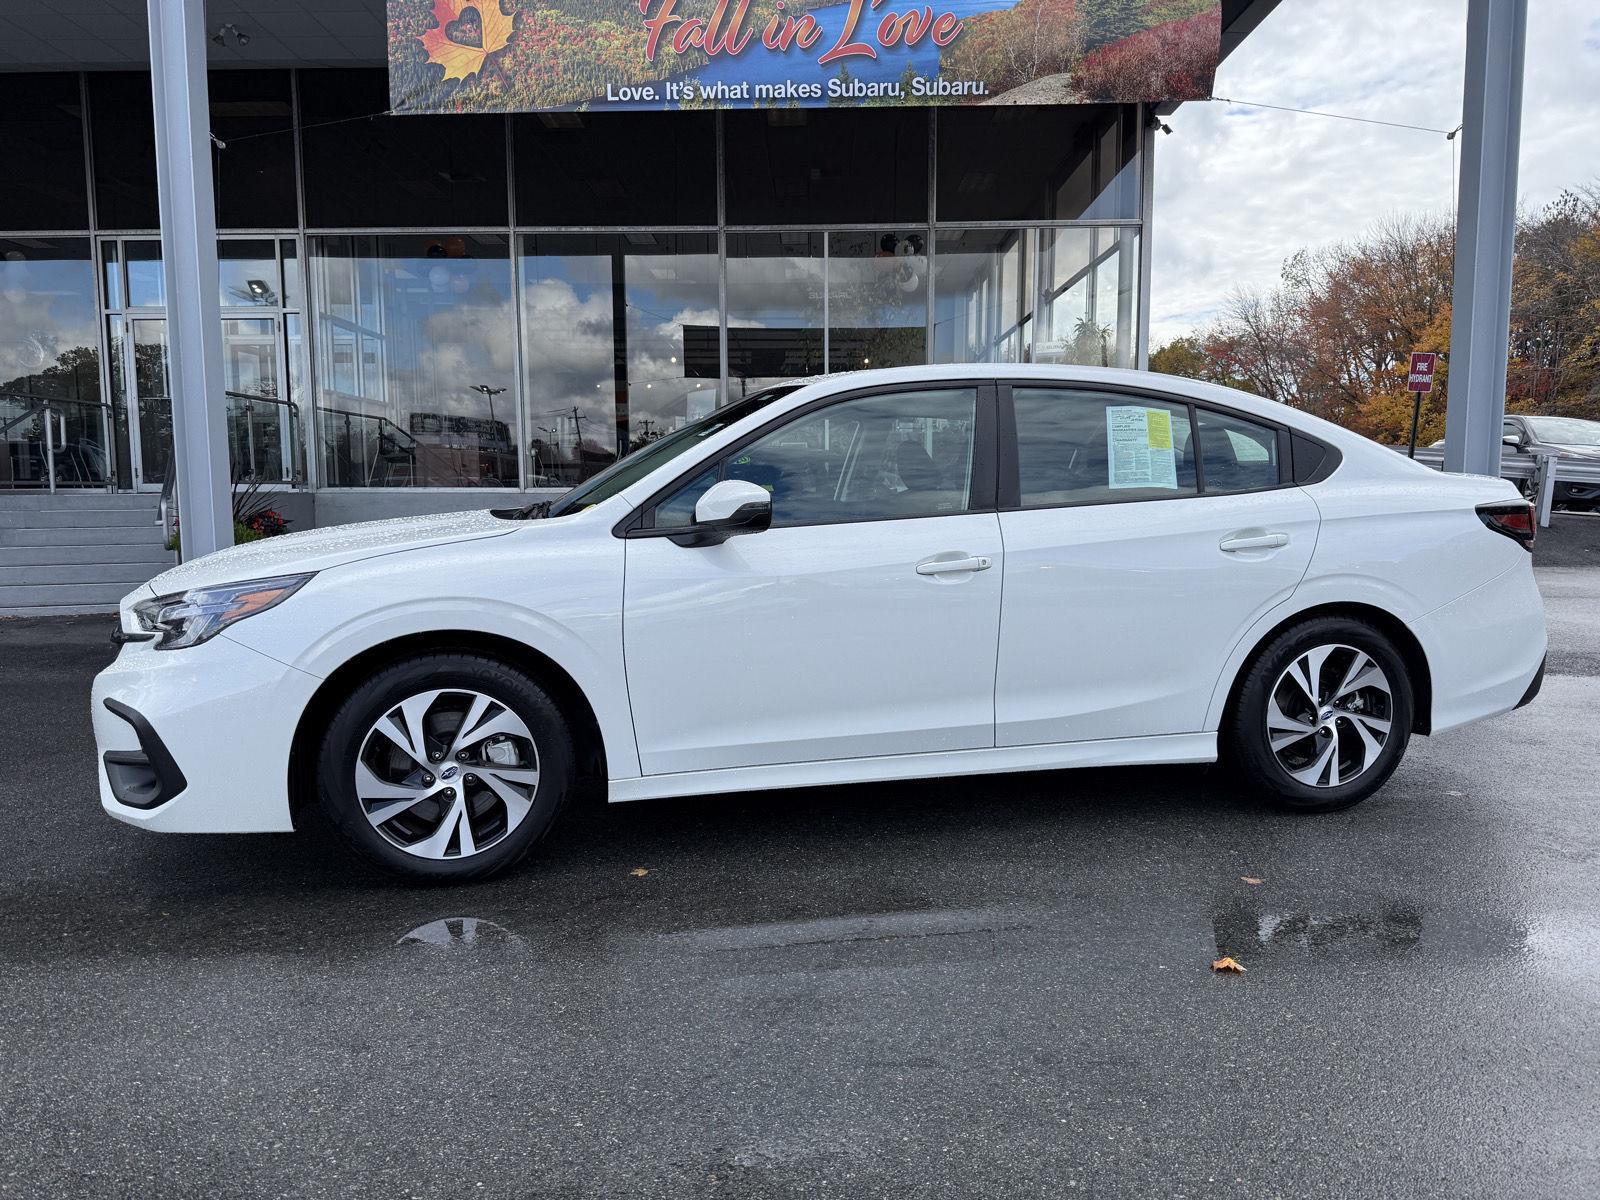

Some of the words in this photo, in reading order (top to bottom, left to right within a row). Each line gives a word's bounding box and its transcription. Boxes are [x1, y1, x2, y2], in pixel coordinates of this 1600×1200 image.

[641, 0, 753, 61] Fall
[761, 1, 822, 50] in
[818, 0, 963, 64] Love
[606, 83, 659, 101] Love.
[666, 81, 694, 100] It’s
[701, 80, 749, 99] what
[755, 79, 822, 99] makes
[828, 78, 905, 99] Subaru,
[911, 76, 989, 96] Subaru.
[1416, 362, 1428, 371] FIRE
[1409, 374, 1432, 382] HYDRANT
